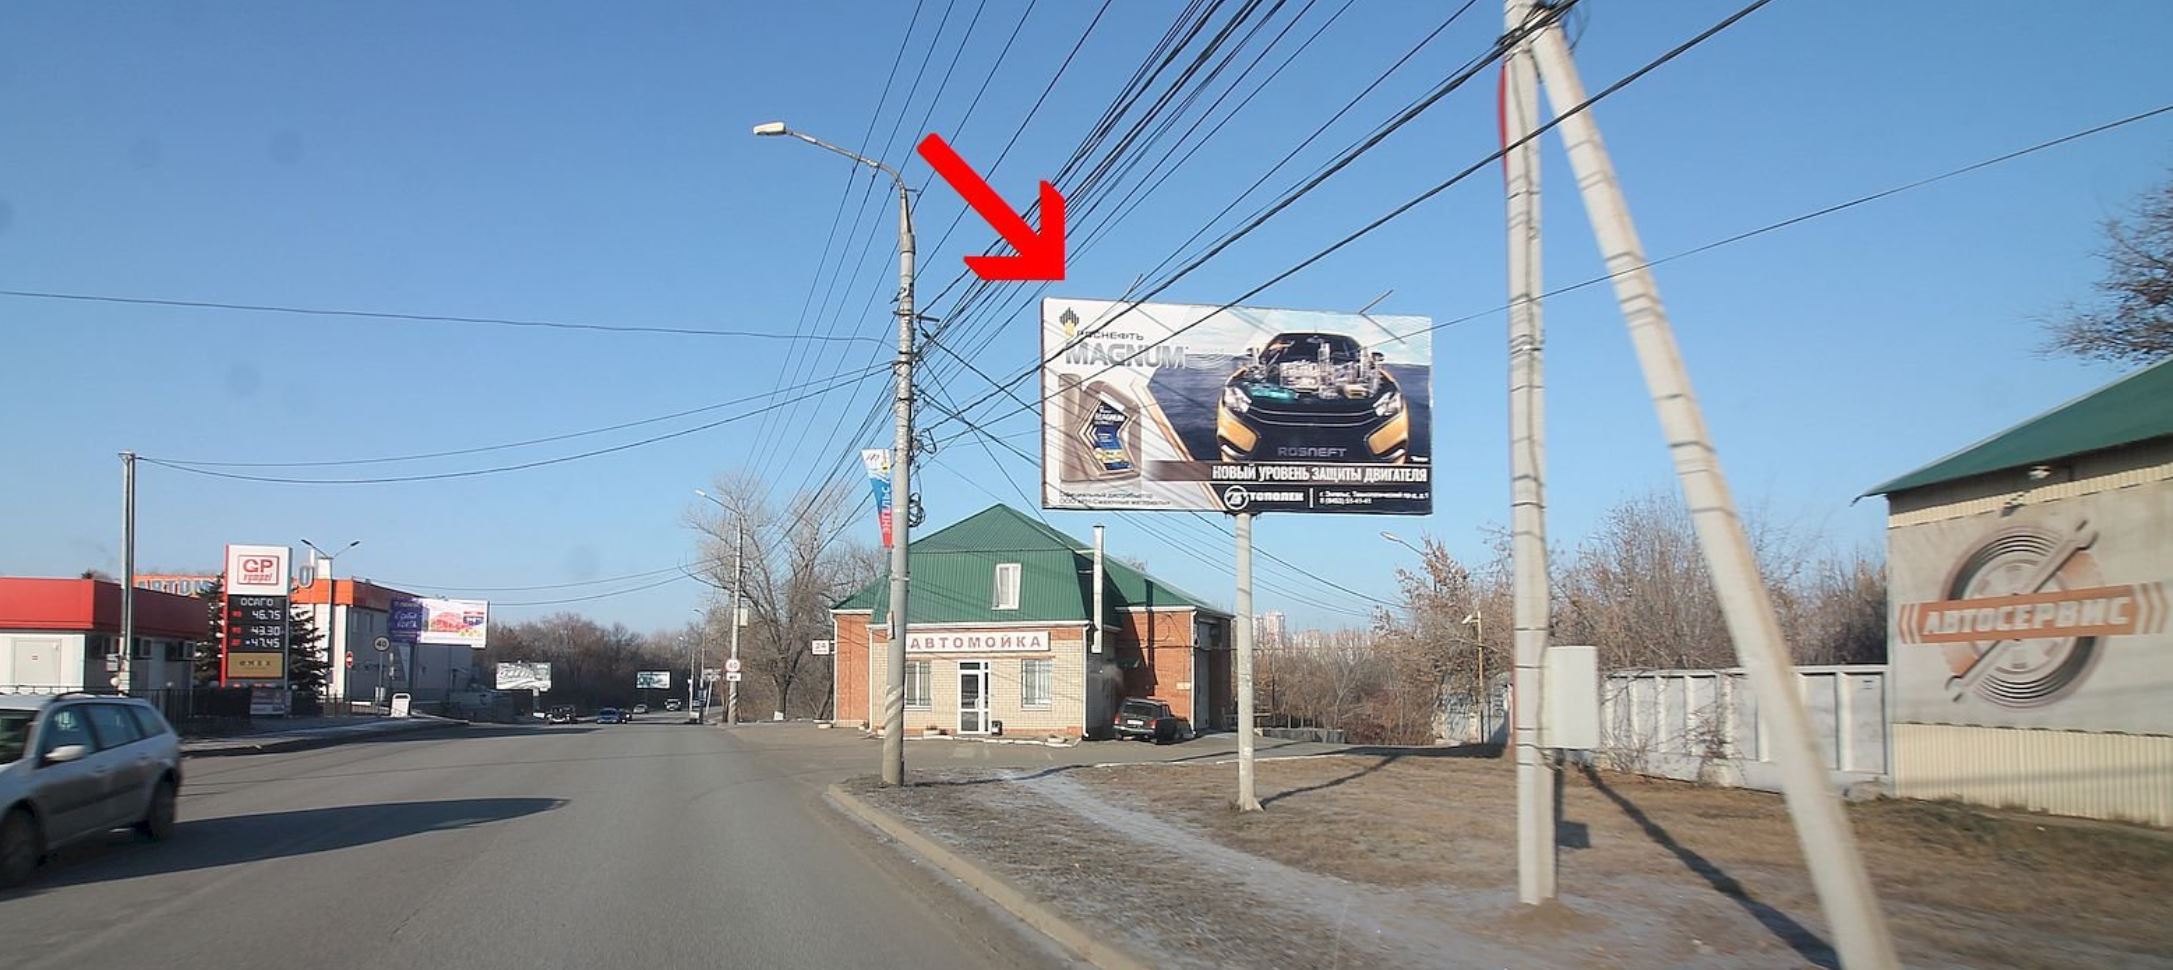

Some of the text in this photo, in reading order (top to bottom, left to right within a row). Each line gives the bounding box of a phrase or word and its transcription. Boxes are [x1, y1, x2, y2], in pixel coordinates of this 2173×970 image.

[1066, 342, 1185, 369] MAGNUM
[1212, 463, 1428, 484] НОВЫЙ УРОВЕНЬ ЗАЩИТЫ ДВИГАТЕЛЯ
[243, 558, 273, 573] GP
[251, 609, 281, 620] 46.75
[1923, 596, 2132, 636] АВТОСЕРВИС
[251, 625, 281, 636] 43.30
[910, 633, 1042, 650] АВТОМОЙКА
